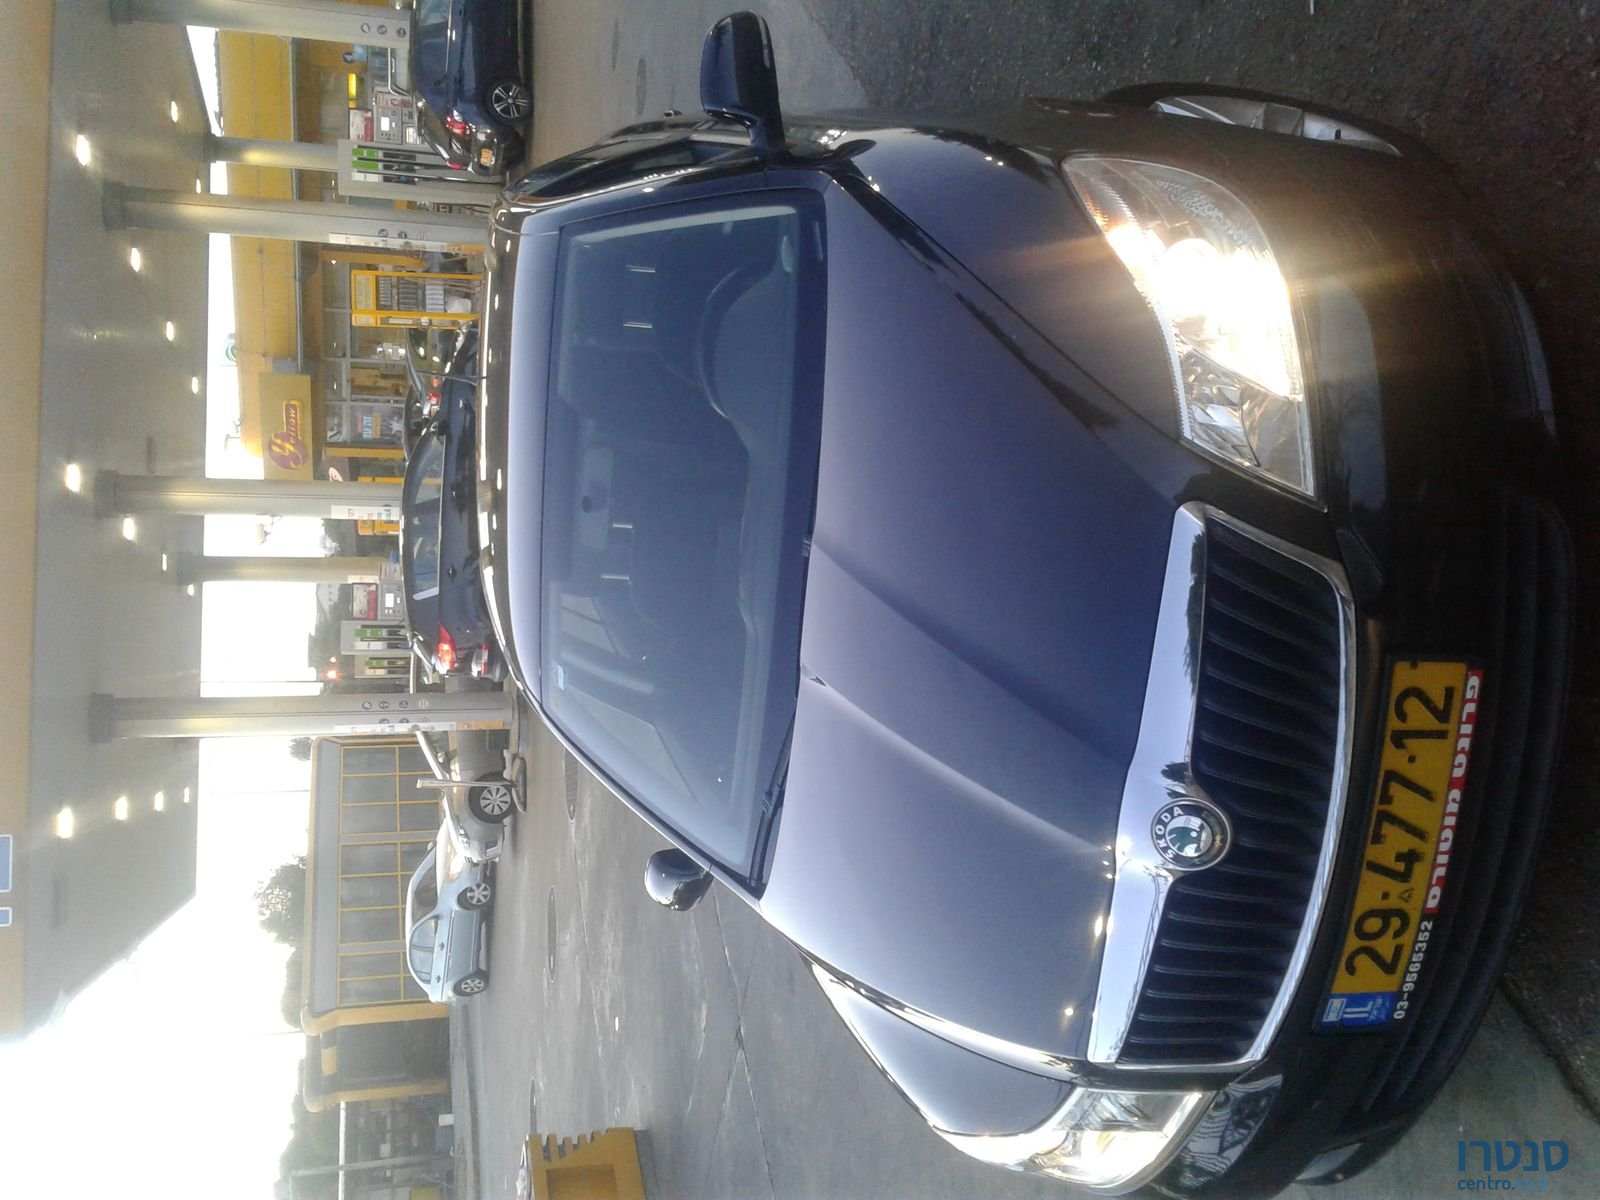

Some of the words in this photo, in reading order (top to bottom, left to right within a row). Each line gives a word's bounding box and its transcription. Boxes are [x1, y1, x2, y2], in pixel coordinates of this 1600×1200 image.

[1451, 674, 1480, 778] פרונט
[1426, 787, 1461, 908] מוטורס
[1343, 999, 1375, 1019] IL
[1392, 919, 1433, 1019] 03-9565352
